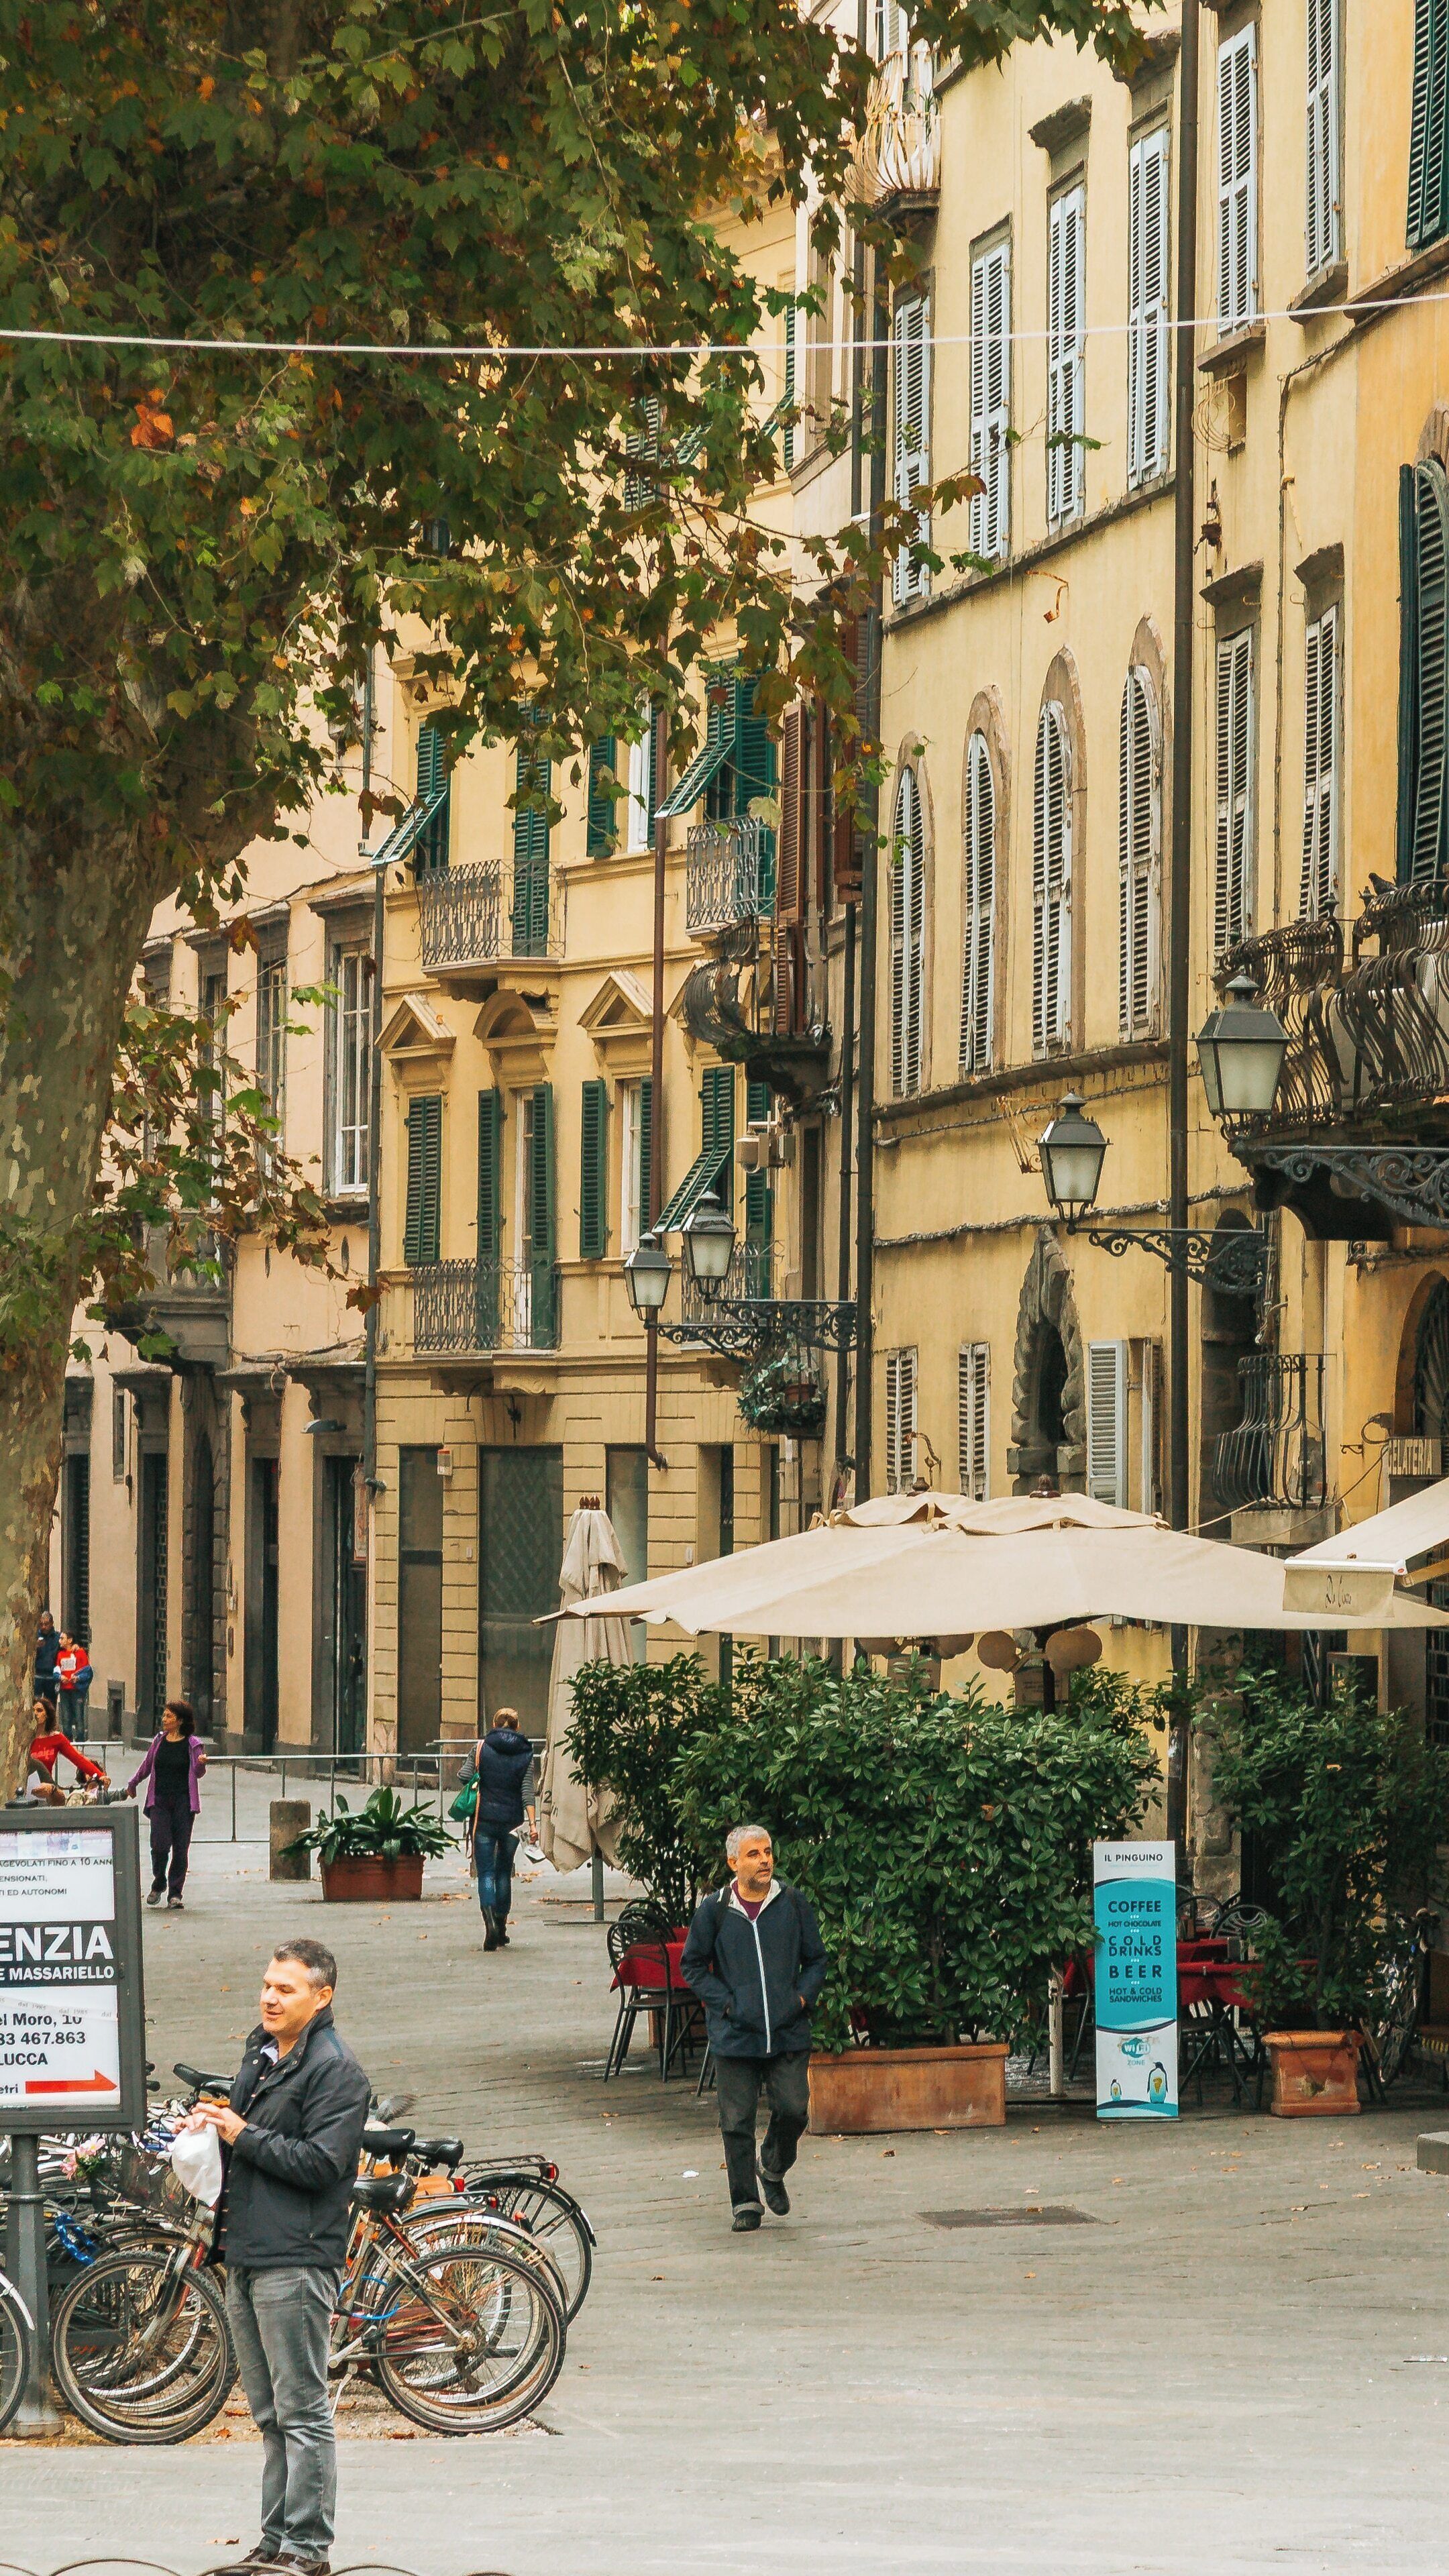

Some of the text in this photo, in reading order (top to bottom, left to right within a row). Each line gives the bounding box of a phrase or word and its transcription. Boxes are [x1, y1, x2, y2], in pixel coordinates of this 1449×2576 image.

[80, 1858, 91, 1866] 10
[1104, 1854, 1163, 1862] IL PINGUINO
[1108, 1900, 1162, 1913] COFFEE
[1108, 1920, 1122, 1928] HOT
[1108, 1935, 1162, 1946] COLD
[1108, 1945, 1162, 1957] DRINKS
[9, 1966, 115, 1981] MASSARIELLO
[1108, 1965, 1162, 1979] BEER
[1109, 1987, 1163, 1995] HOT & COLD
[1109, 1994, 1163, 2003] SANDWICHES
[13, 2012, 57, 2028] Moro,
[20, 2031, 86, 2045] 467.863
